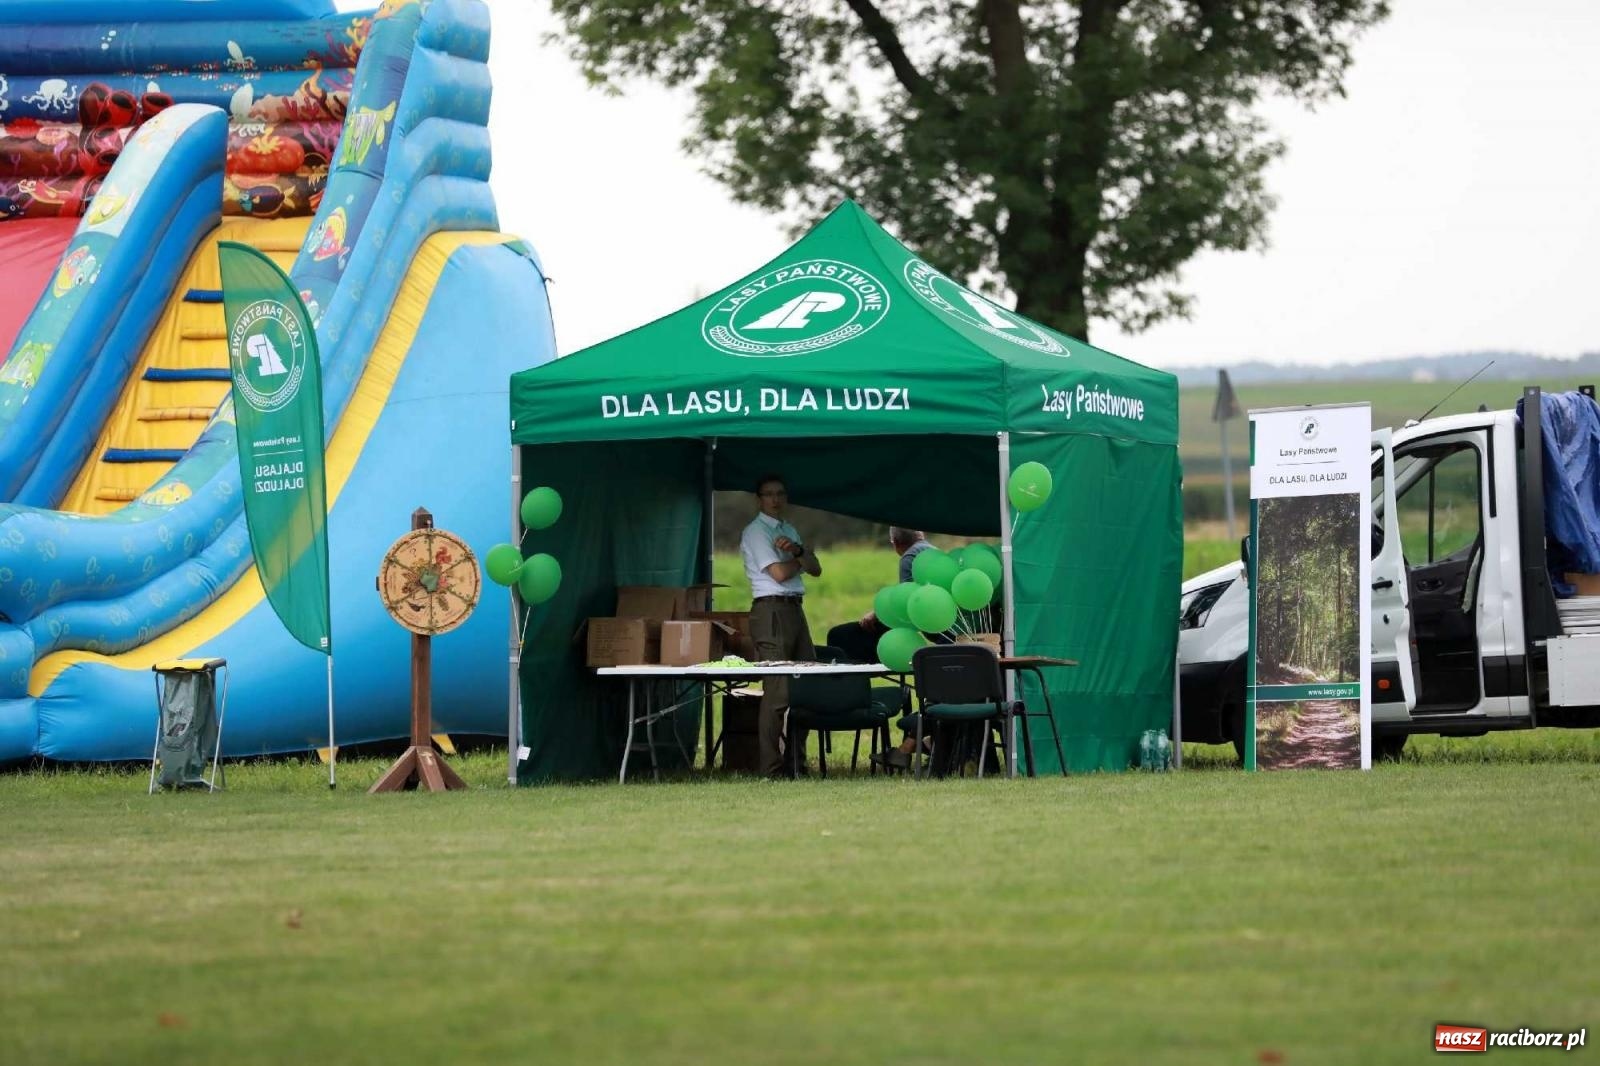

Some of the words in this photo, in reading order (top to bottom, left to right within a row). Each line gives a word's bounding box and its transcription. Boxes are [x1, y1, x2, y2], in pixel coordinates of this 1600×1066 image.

[719, 279, 768, 313] LASY
[775, 262, 883, 312] PAŃSTWOWE
[601, 394, 660, 418] DLA
[666, 389, 750, 417] LASU,
[760, 387, 819, 412] DLA
[826, 387, 911, 411] LUDZI
[1041, 384, 1073, 420] Lasy
[1076, 383, 1145, 421] Państwowe
[1279, 449, 1297, 457] Lasy
[1269, 476, 1285, 485] DLA
[1309, 474, 1325, 482] DLA
[1308, 688, 1354, 697] www.lasy.gov.pl
